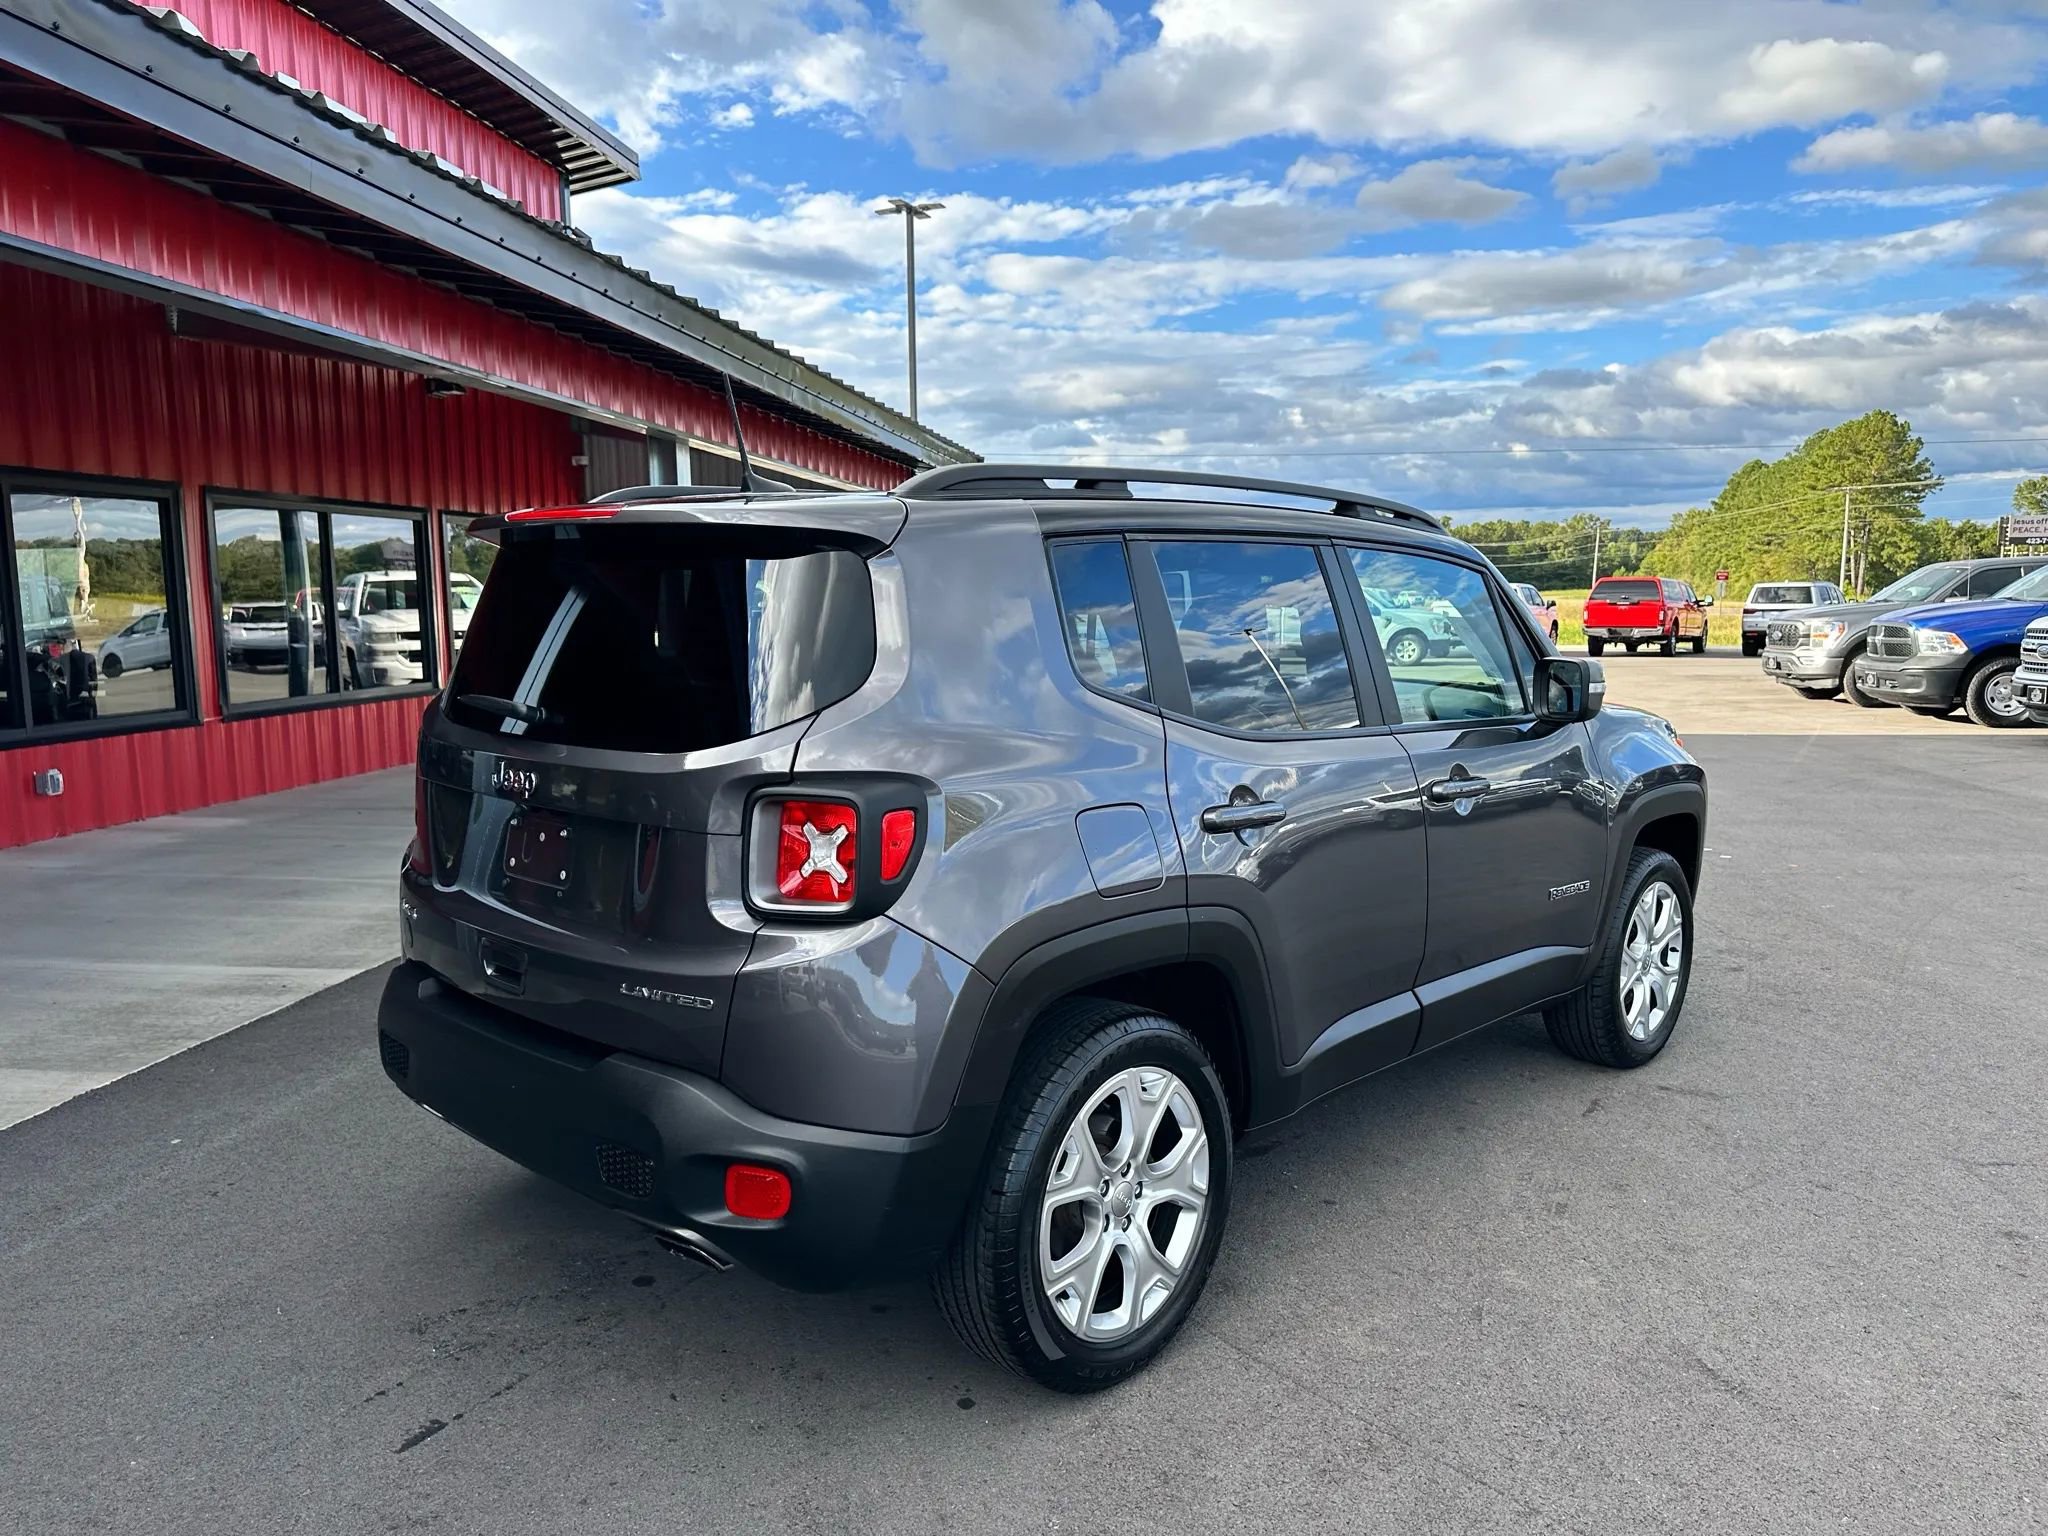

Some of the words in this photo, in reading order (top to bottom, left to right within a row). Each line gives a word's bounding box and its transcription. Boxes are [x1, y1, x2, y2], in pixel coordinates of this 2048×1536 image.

[491, 760, 538, 799] Jeep
[1549, 880, 1591, 901] RENEGADE
[620, 983, 714, 1010] LIMITED
